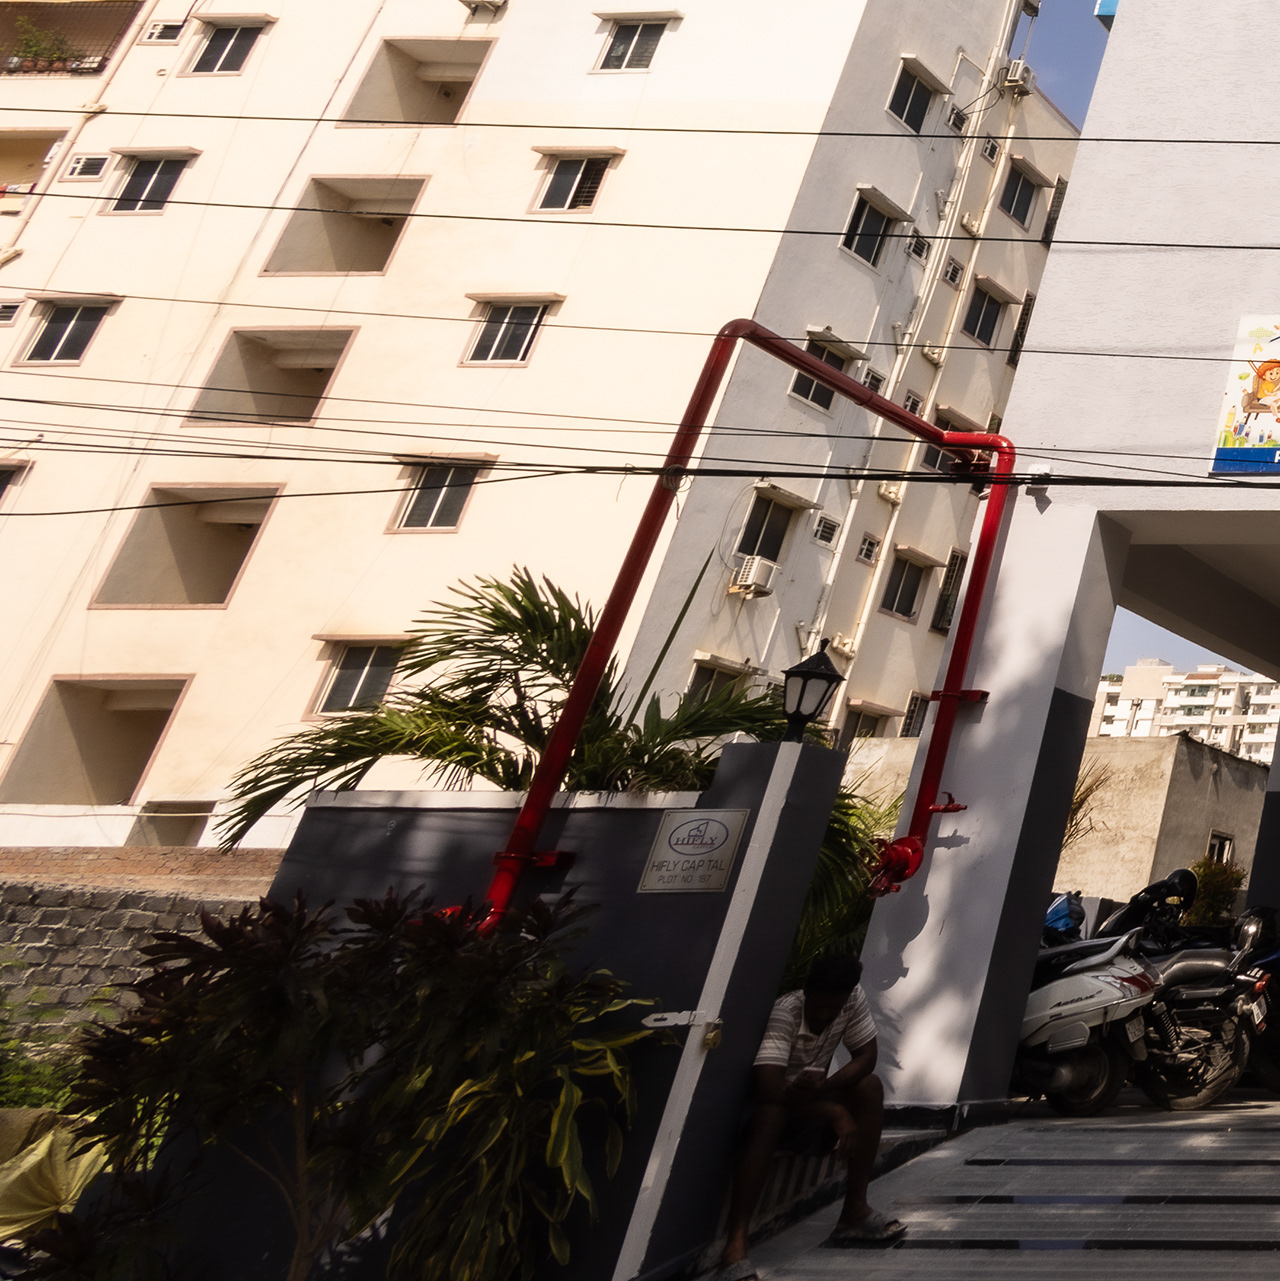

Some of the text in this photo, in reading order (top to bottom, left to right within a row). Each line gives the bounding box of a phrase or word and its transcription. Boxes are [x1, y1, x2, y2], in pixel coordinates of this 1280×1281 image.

[675, 837, 718, 845] HIFLY
[650, 860, 680, 872] HIFLY
[658, 875, 711, 883] PLOT NO 187
